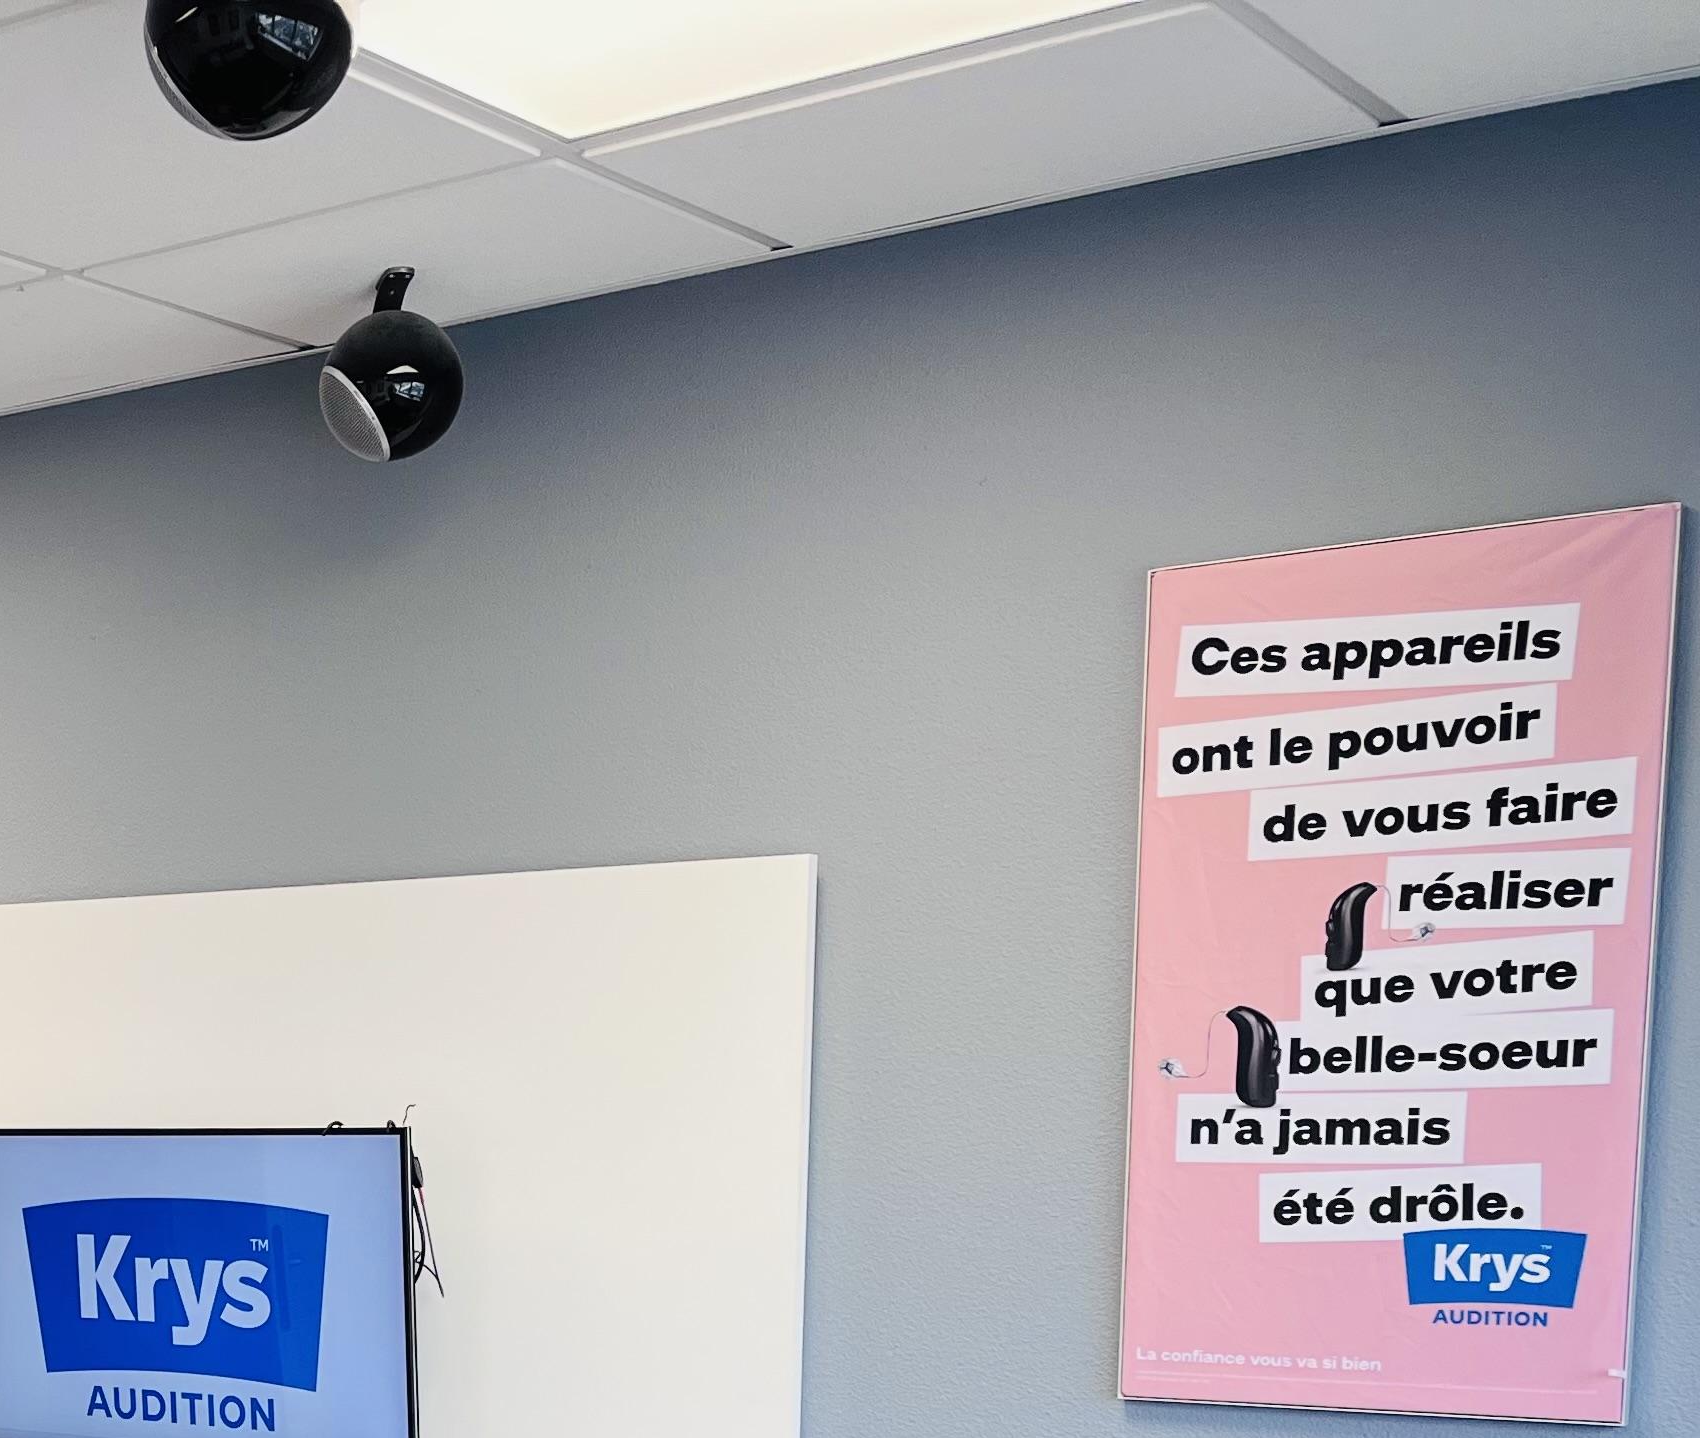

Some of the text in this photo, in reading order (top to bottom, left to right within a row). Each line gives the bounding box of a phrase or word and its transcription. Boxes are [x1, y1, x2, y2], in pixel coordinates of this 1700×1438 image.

[1191, 620, 1562, 681] Ces appareils
[1172, 702, 1541, 775] ont le pouvoir
[1263, 783, 1618, 843] de vous faire
[1398, 870, 1614, 912] réaliser
[1314, 960, 1578, 1018] que votre
[1288, 1034, 1598, 1075] belle-soeur
[1190, 1107, 1451, 1155] n'a jamais
[1273, 1182, 1524, 1226] été drôle.
[76, 1233, 272, 1346] Krys
[1433, 1243, 1551, 1292] Krys
[1432, 1309, 1549, 1328] AUDITION
[1136, 1347, 1382, 1372] La confiance vous va si bien
[86, 1385, 277, 1432] AUDITION
